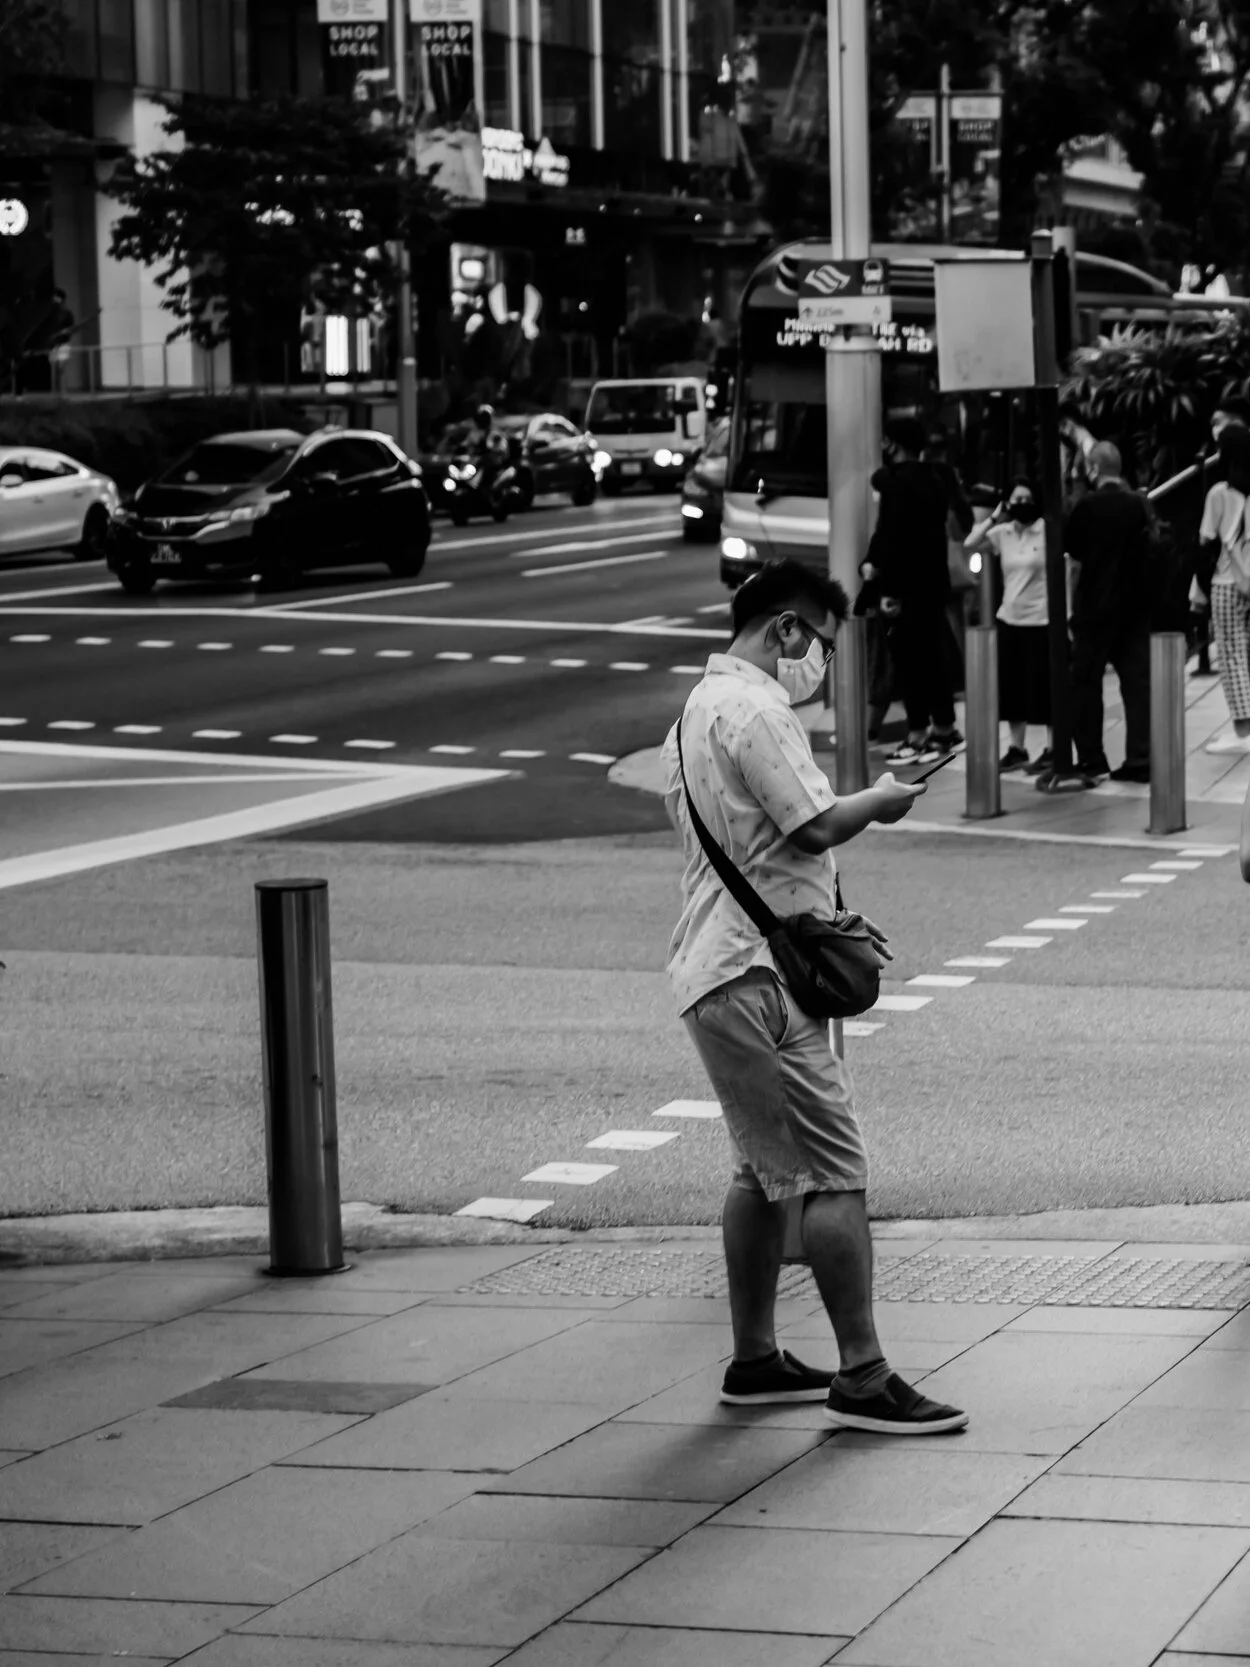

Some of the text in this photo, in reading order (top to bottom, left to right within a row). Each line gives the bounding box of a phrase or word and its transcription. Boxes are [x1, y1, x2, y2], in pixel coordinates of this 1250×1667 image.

[329, 25, 379, 41] SHOP
[421, 25, 471, 41] SHOP
[329, 43, 379, 57] LOCAL
[421, 42, 471, 57] LOCAL
